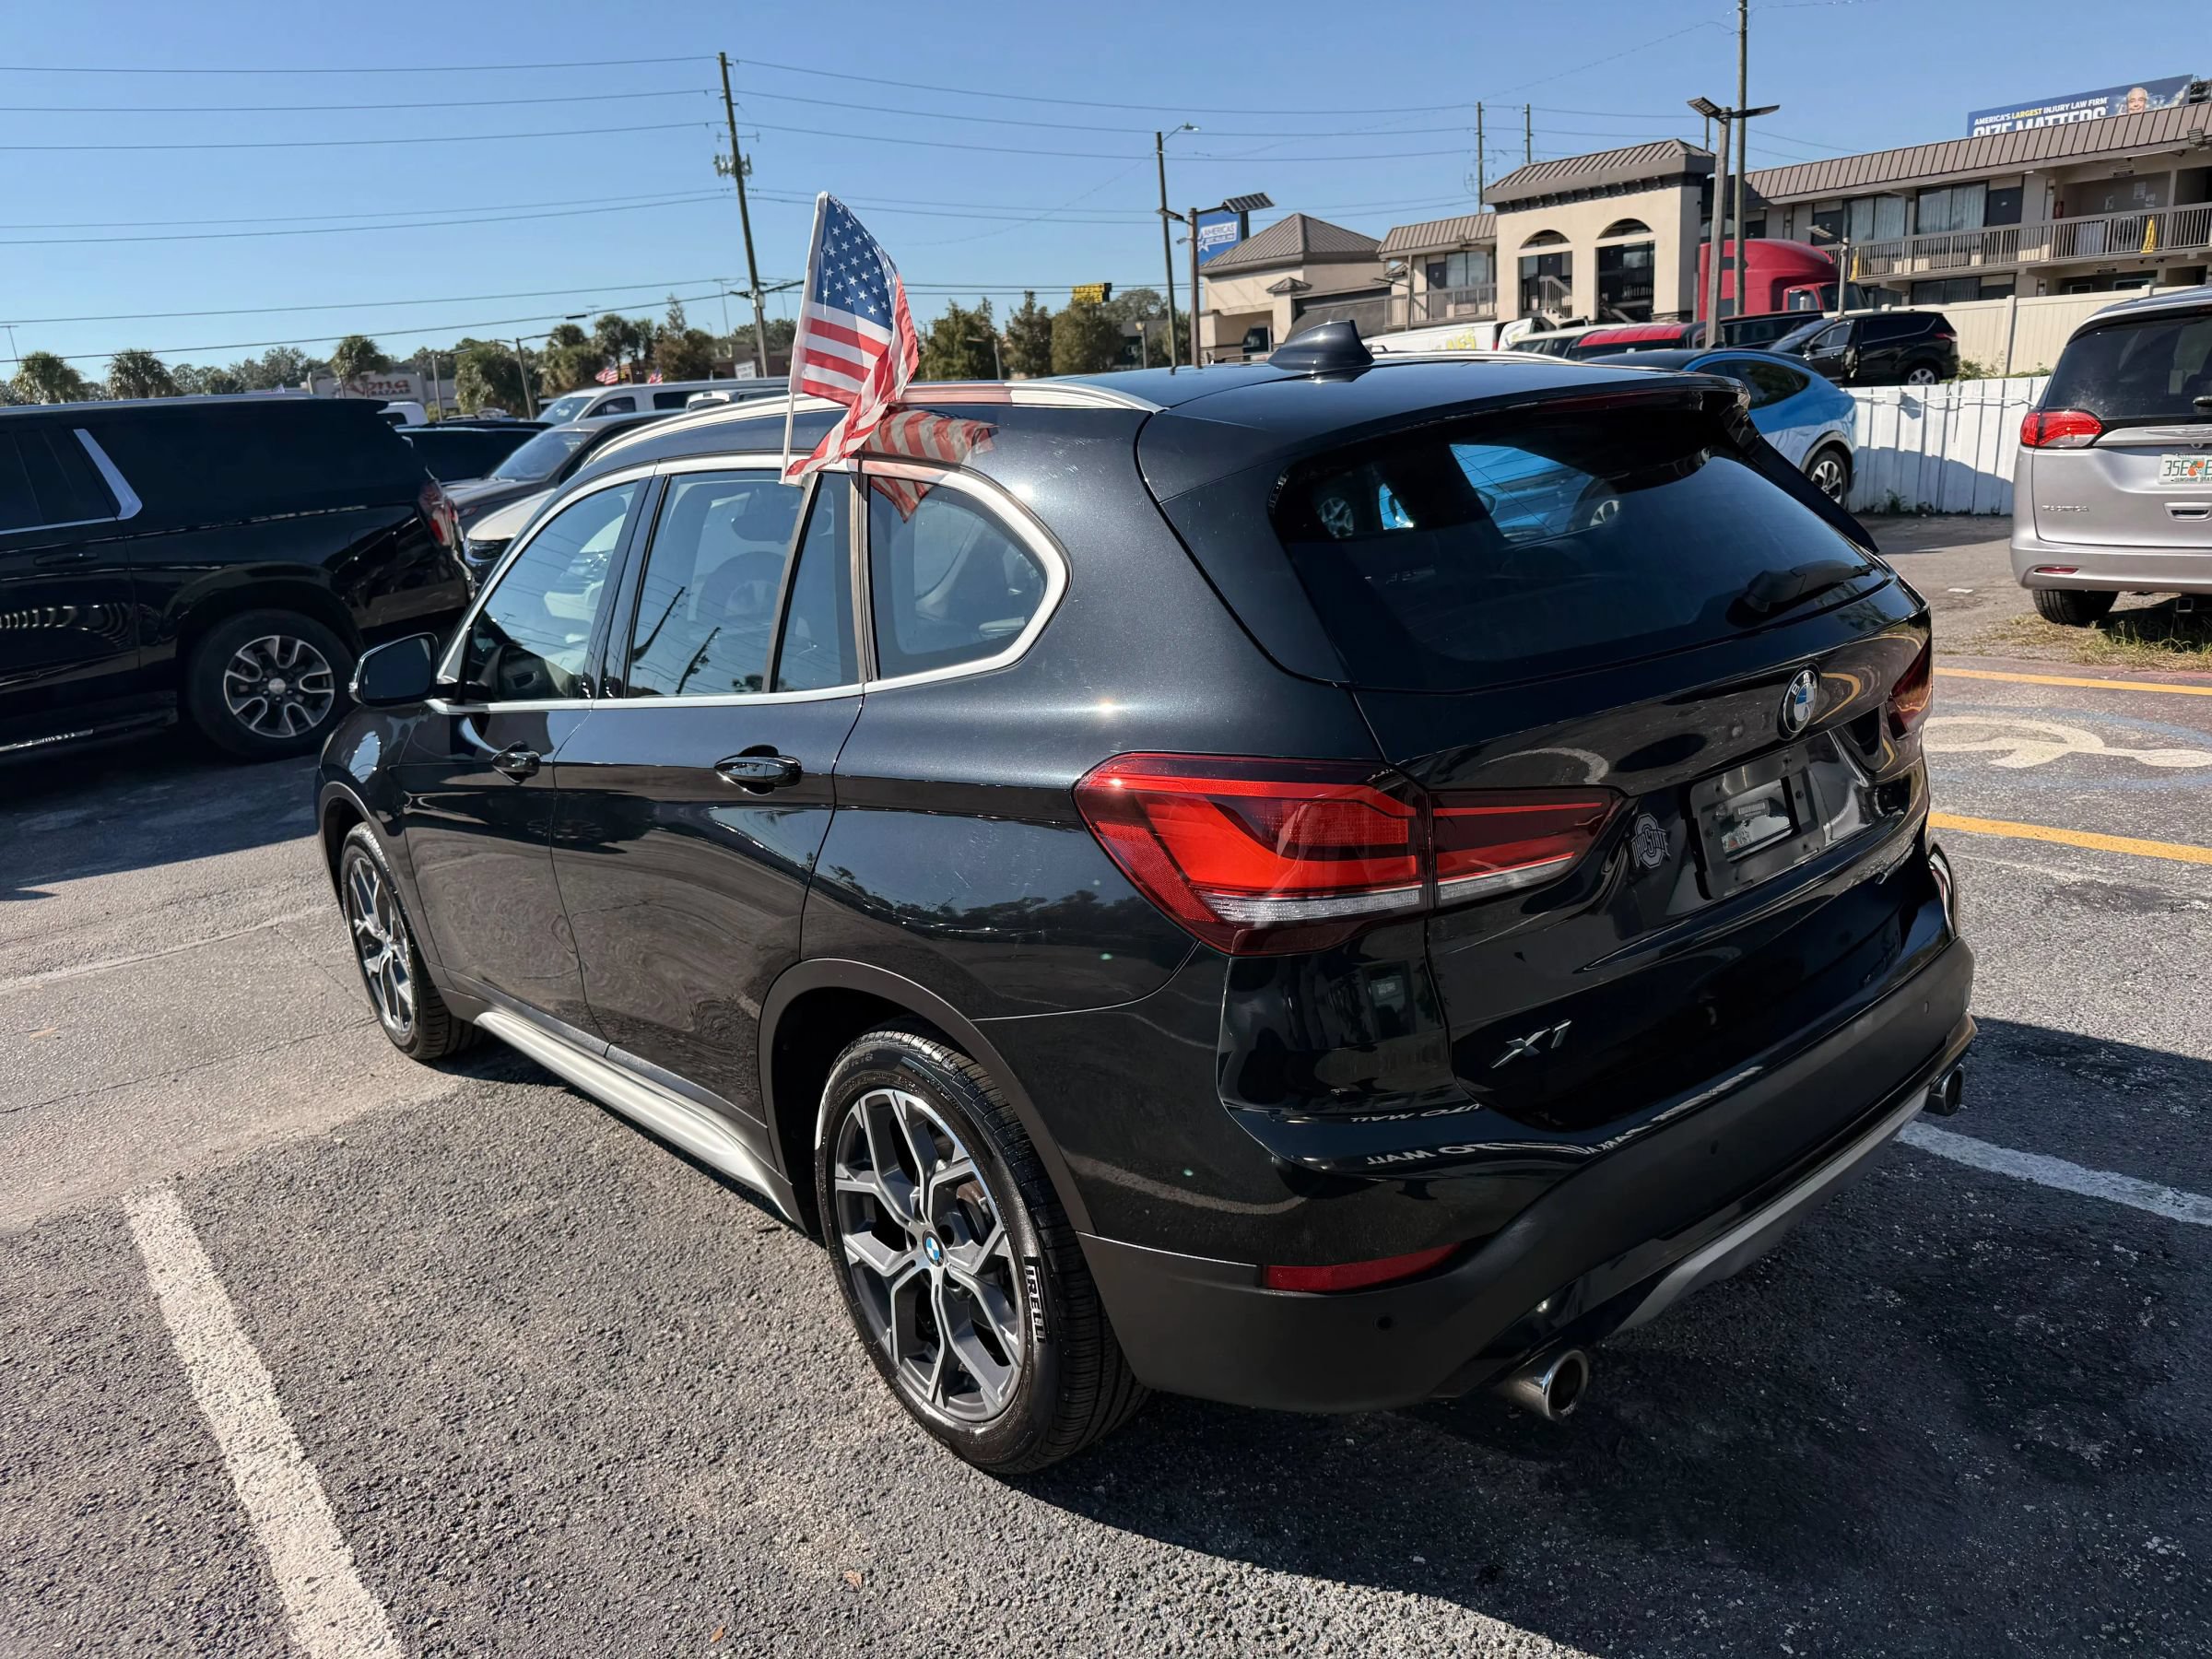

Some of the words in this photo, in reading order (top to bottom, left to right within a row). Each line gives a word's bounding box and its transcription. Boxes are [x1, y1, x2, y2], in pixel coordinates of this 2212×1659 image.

[1974, 113, 2010, 125] AMERICA'S
[2011, 108, 2042, 120] LARGEST
[2043, 103, 2070, 114] INJURY
[2071, 100, 2087, 110] LAW
[2088, 97, 2107, 107] FIRM
[1631, 832, 1648, 868] OHIO
[1645, 828, 1671, 857] STATE
[1490, 1018, 1571, 1069] X1
